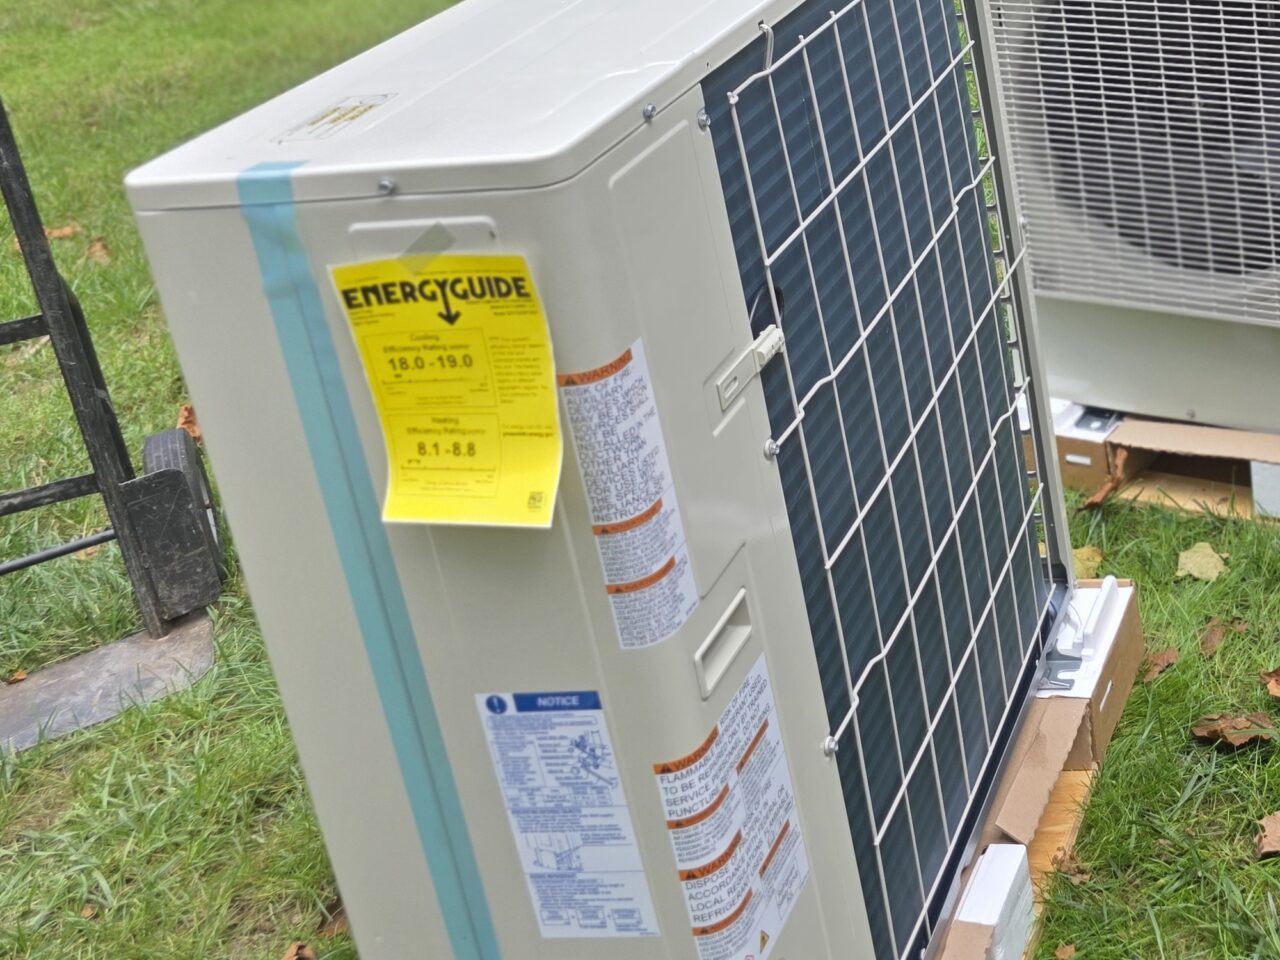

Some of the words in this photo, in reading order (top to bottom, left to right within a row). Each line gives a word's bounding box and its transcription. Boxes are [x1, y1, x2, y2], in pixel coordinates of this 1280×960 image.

[341, 276, 531, 310] ENERGYGUIDE
[388, 356, 425, 371] 18.0
[437, 354, 473, 369] 19.0
[536, 695, 580, 707] NOTICE
[662, 786, 676, 795] TO
[679, 778, 696, 792] BE
[664, 781, 710, 807] SERVICE
[690, 893, 725, 911] LOCAL
